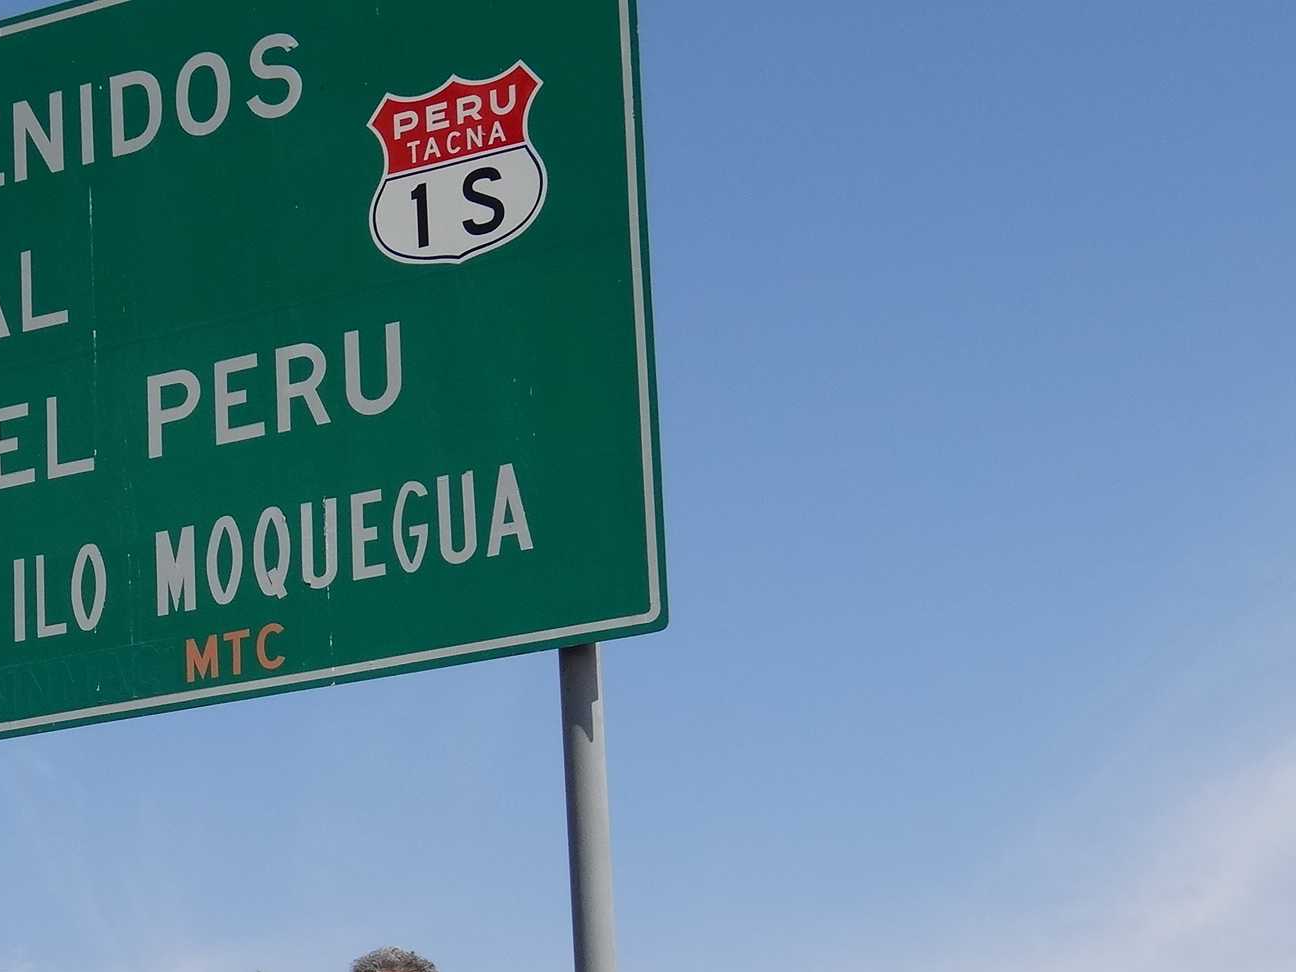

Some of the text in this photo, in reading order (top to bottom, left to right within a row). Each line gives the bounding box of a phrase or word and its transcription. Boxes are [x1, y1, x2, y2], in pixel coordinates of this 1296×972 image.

[393, 84, 517, 141] PERU
[407, 121, 506, 164] TACNA
[411, 166, 505, 249] 1 S
[146, 321, 402, 459] PERU
[13, 543, 107, 643] ILO
[155, 463, 534, 617] MOQUEGUA
[185, 622, 285, 684] MTC
